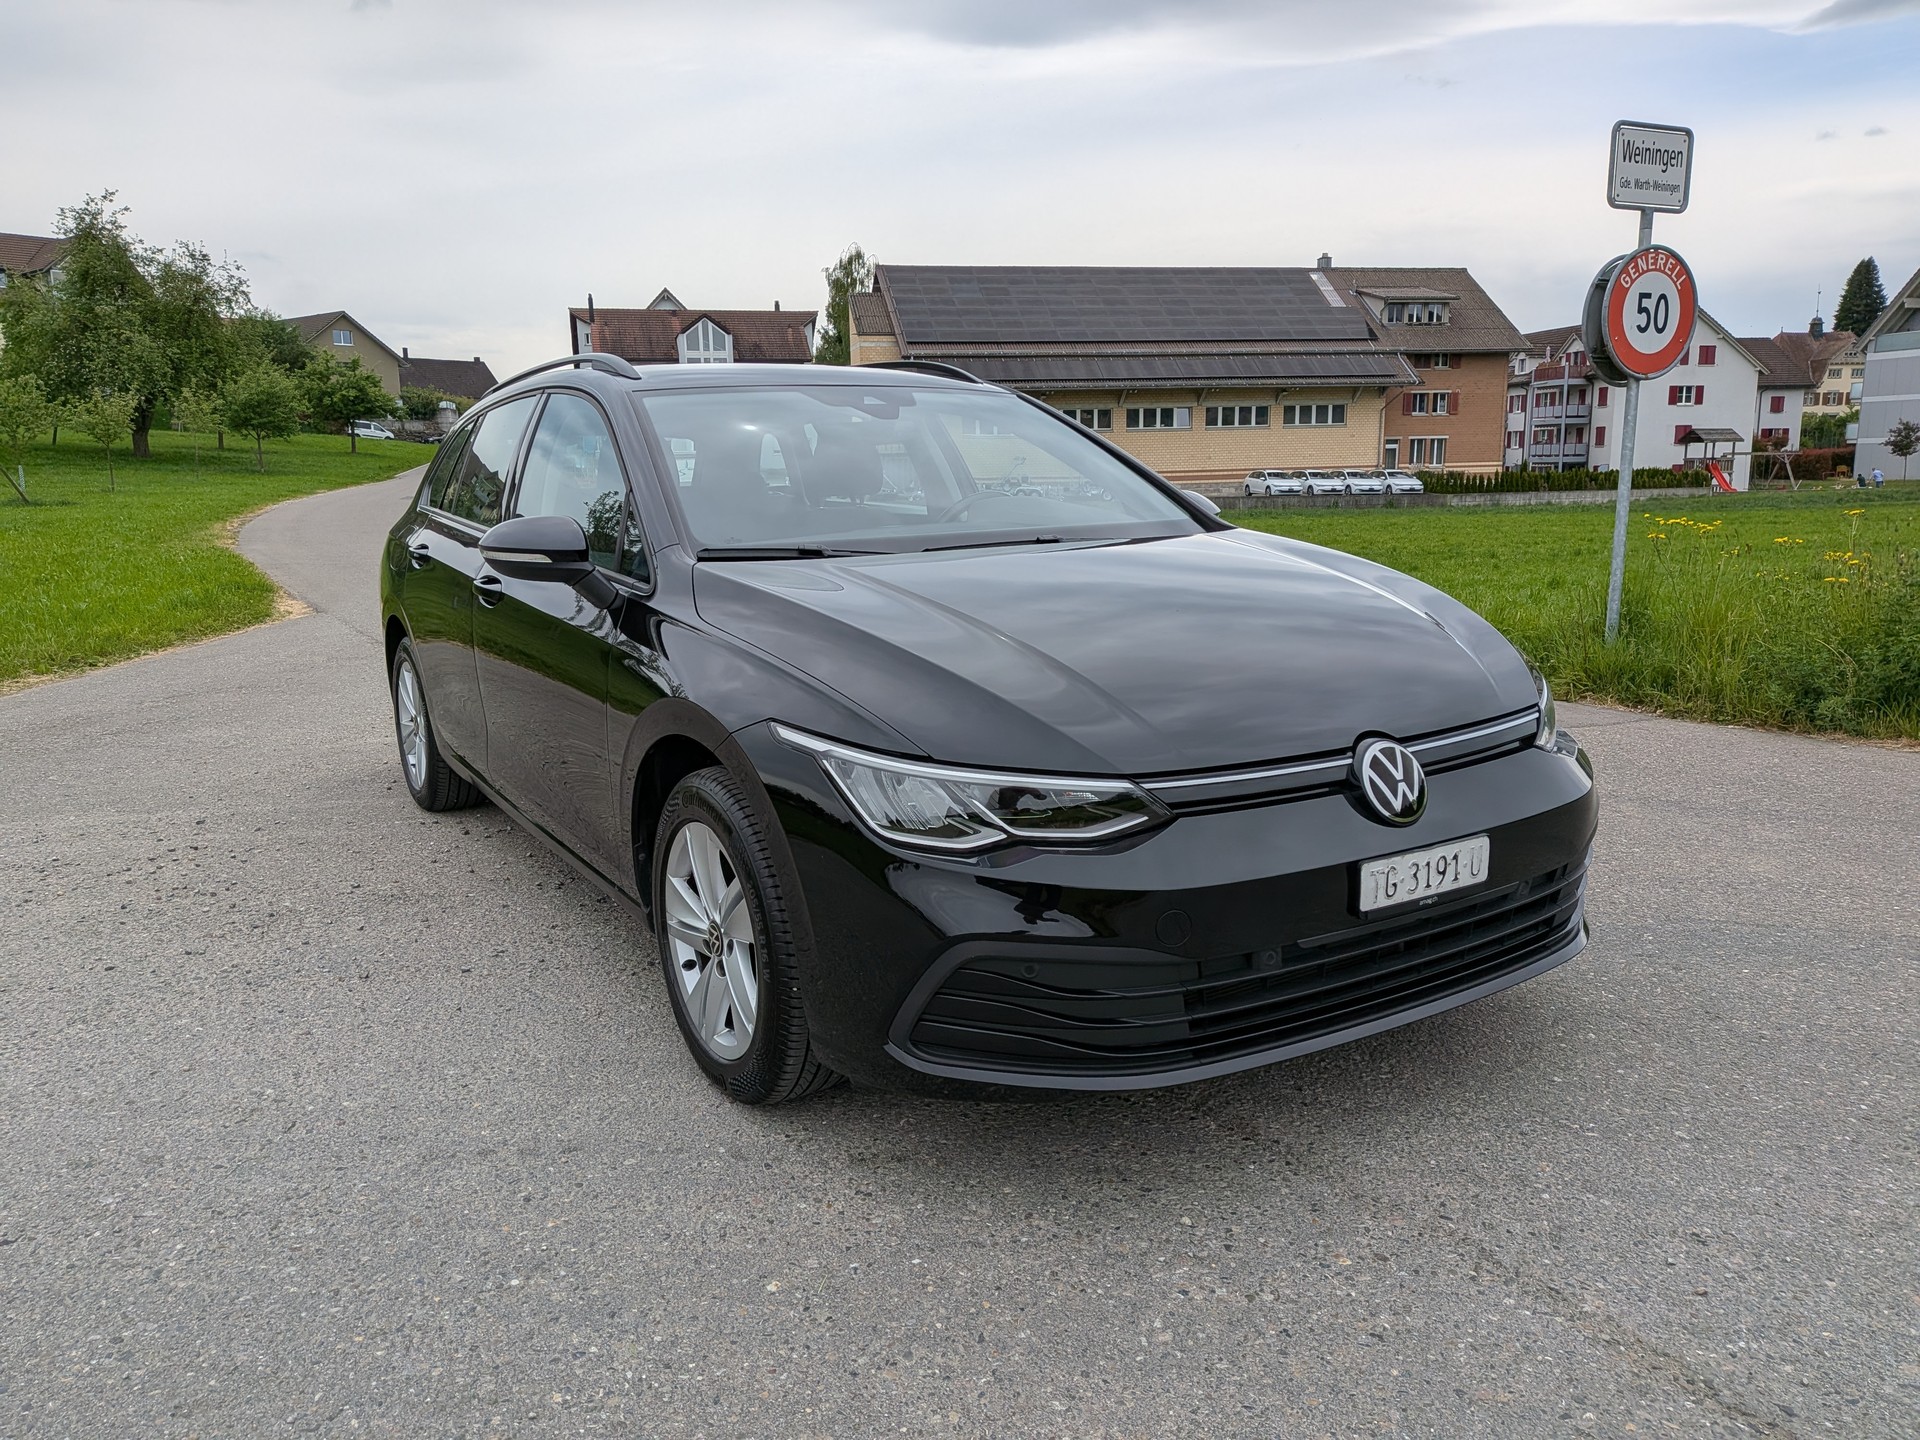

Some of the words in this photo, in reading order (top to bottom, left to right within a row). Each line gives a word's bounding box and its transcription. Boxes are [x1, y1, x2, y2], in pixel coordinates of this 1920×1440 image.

[1622, 139, 1683, 173] Weiningen
[1619, 176, 1633, 190] Gde.
[1634, 178, 1680, 195] Warth-Weiningen
[1620, 252, 1688, 290] GENERELL
[1636, 292, 1670, 335] 50
